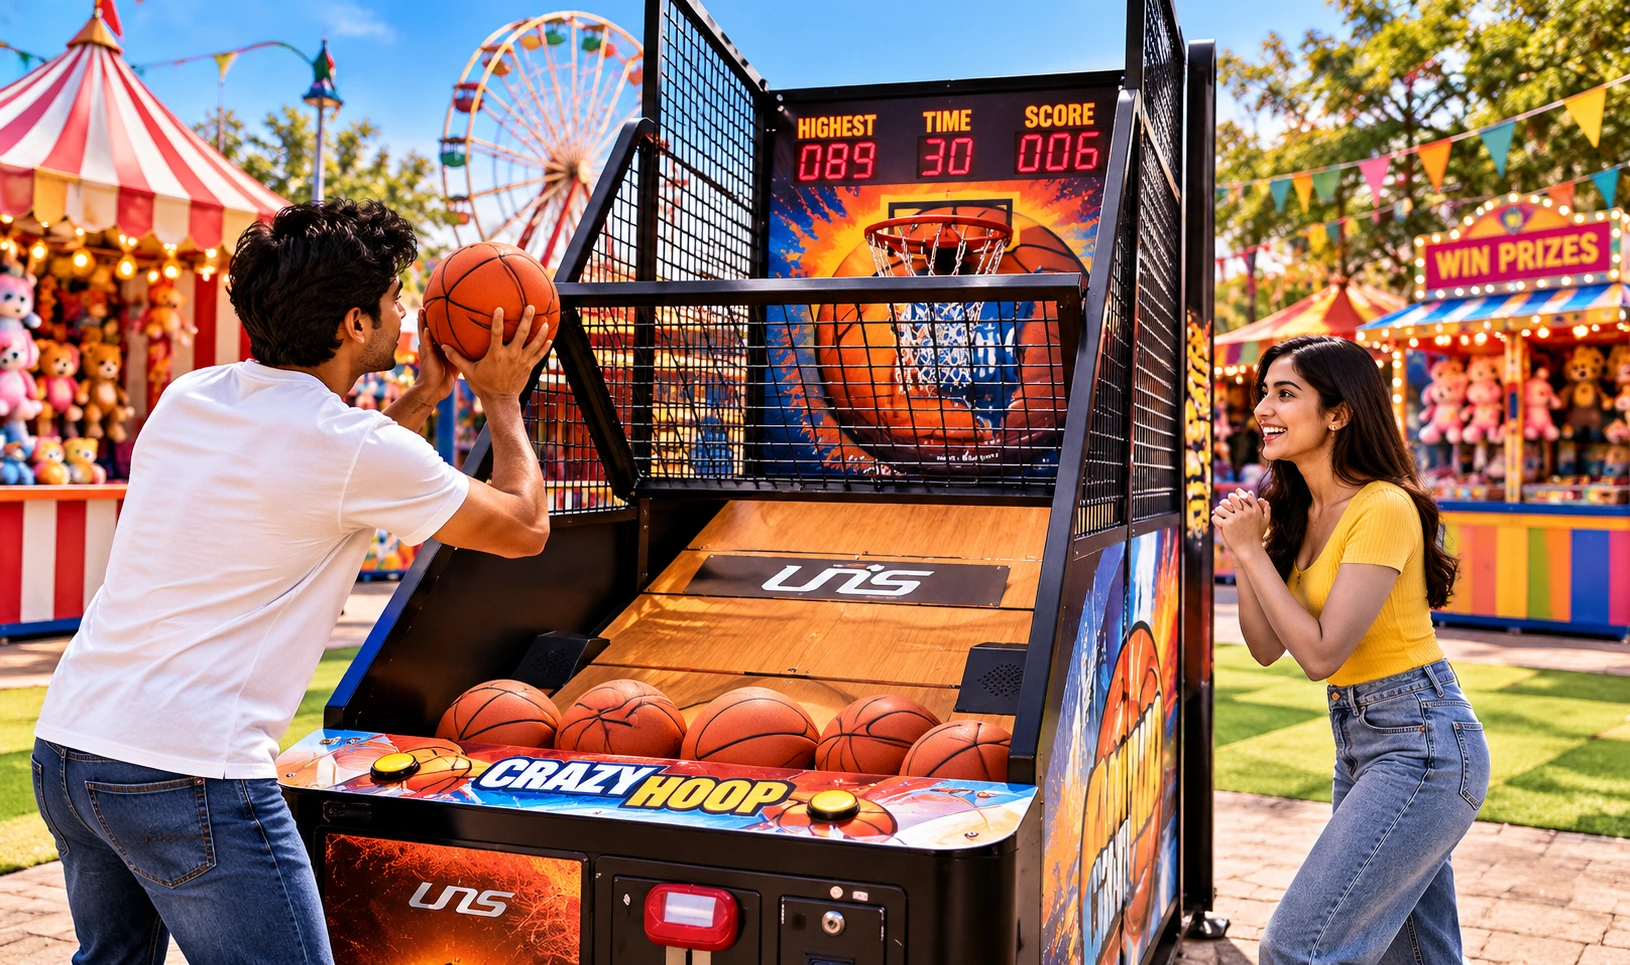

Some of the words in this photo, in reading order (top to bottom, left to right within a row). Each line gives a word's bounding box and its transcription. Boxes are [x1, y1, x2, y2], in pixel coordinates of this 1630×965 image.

[798, 114, 877, 139] HIGHEST
[923, 109, 972, 133] TIME
[1025, 102, 1096, 128] SCORE
[799, 142, 876, 181] 089
[921, 137, 974, 176] 30
[1018, 131, 1100, 173] 006
[1435, 245, 1491, 280] WIN
[1498, 231, 1599, 274] PRIZES
[479, 758, 657, 796] CRAZY
[625, 775, 791, 814] HOOP
